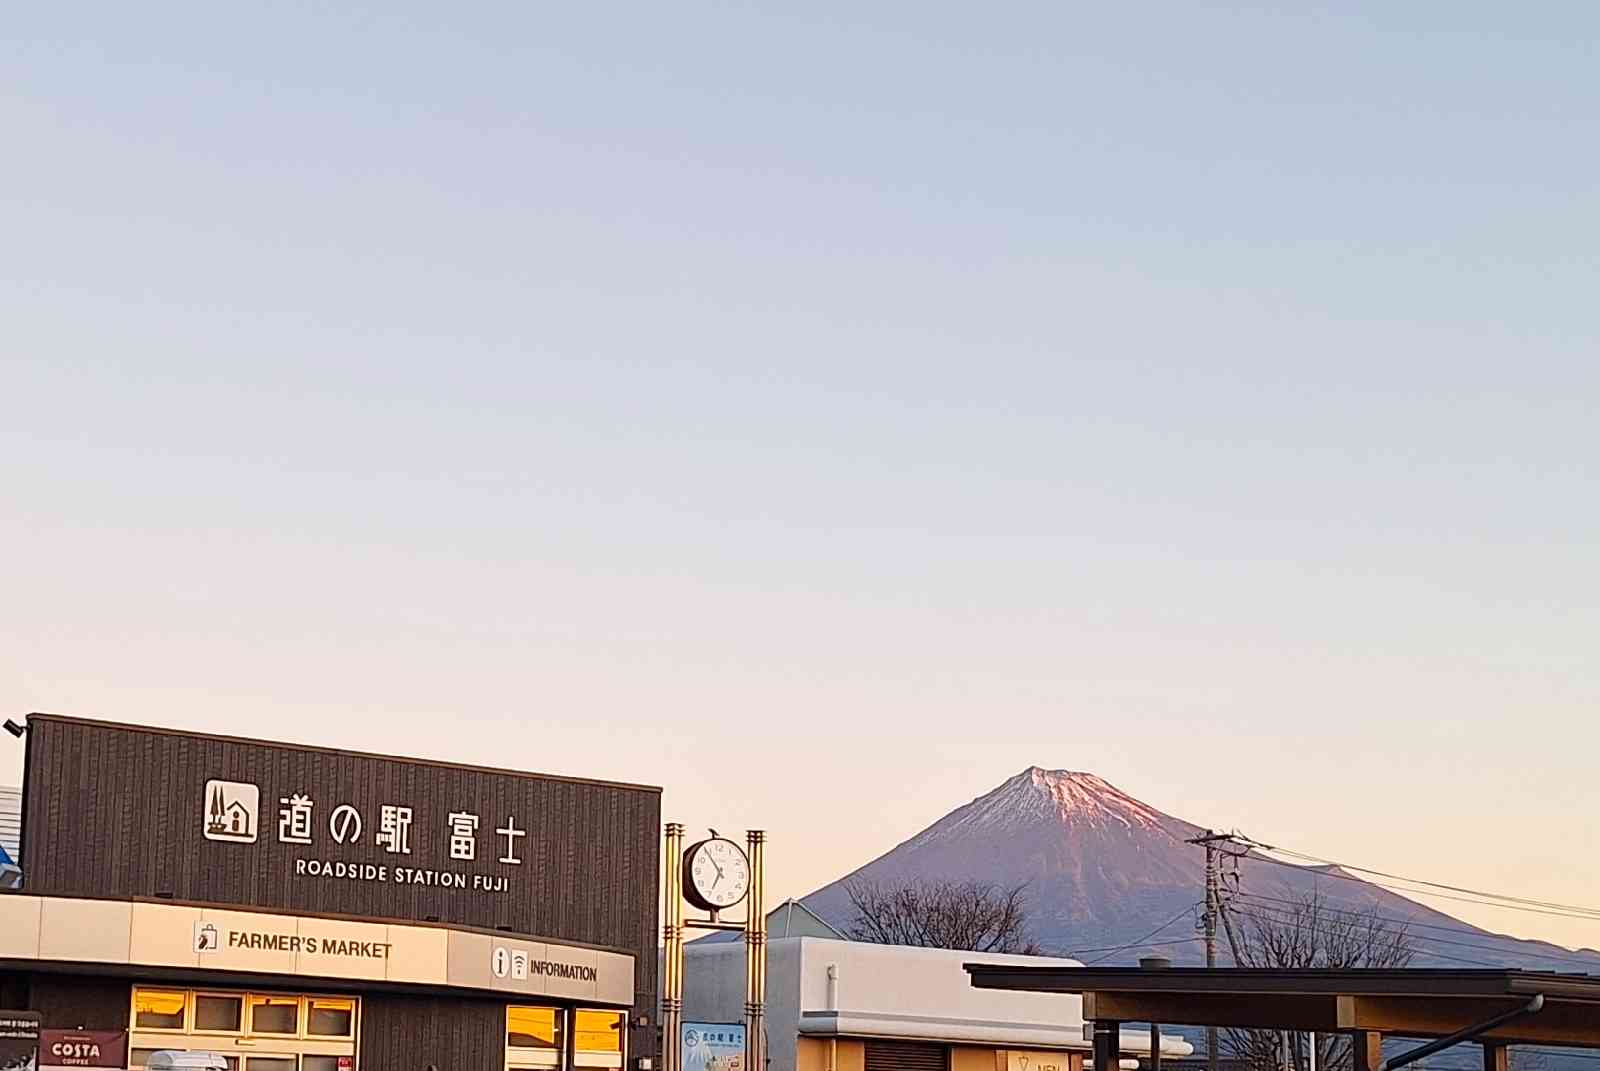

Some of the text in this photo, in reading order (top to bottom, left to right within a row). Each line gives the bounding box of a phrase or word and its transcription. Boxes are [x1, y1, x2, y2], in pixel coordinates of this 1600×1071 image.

[279, 793, 526, 864] 道の駅 富士
[296, 859, 509, 892] ROADSIDE STATION FUJI
[229, 931, 392, 960] FARMER'S MARKET
[530, 960, 597, 982] INFORMATION
[52, 1043, 100, 1058] COSTA
